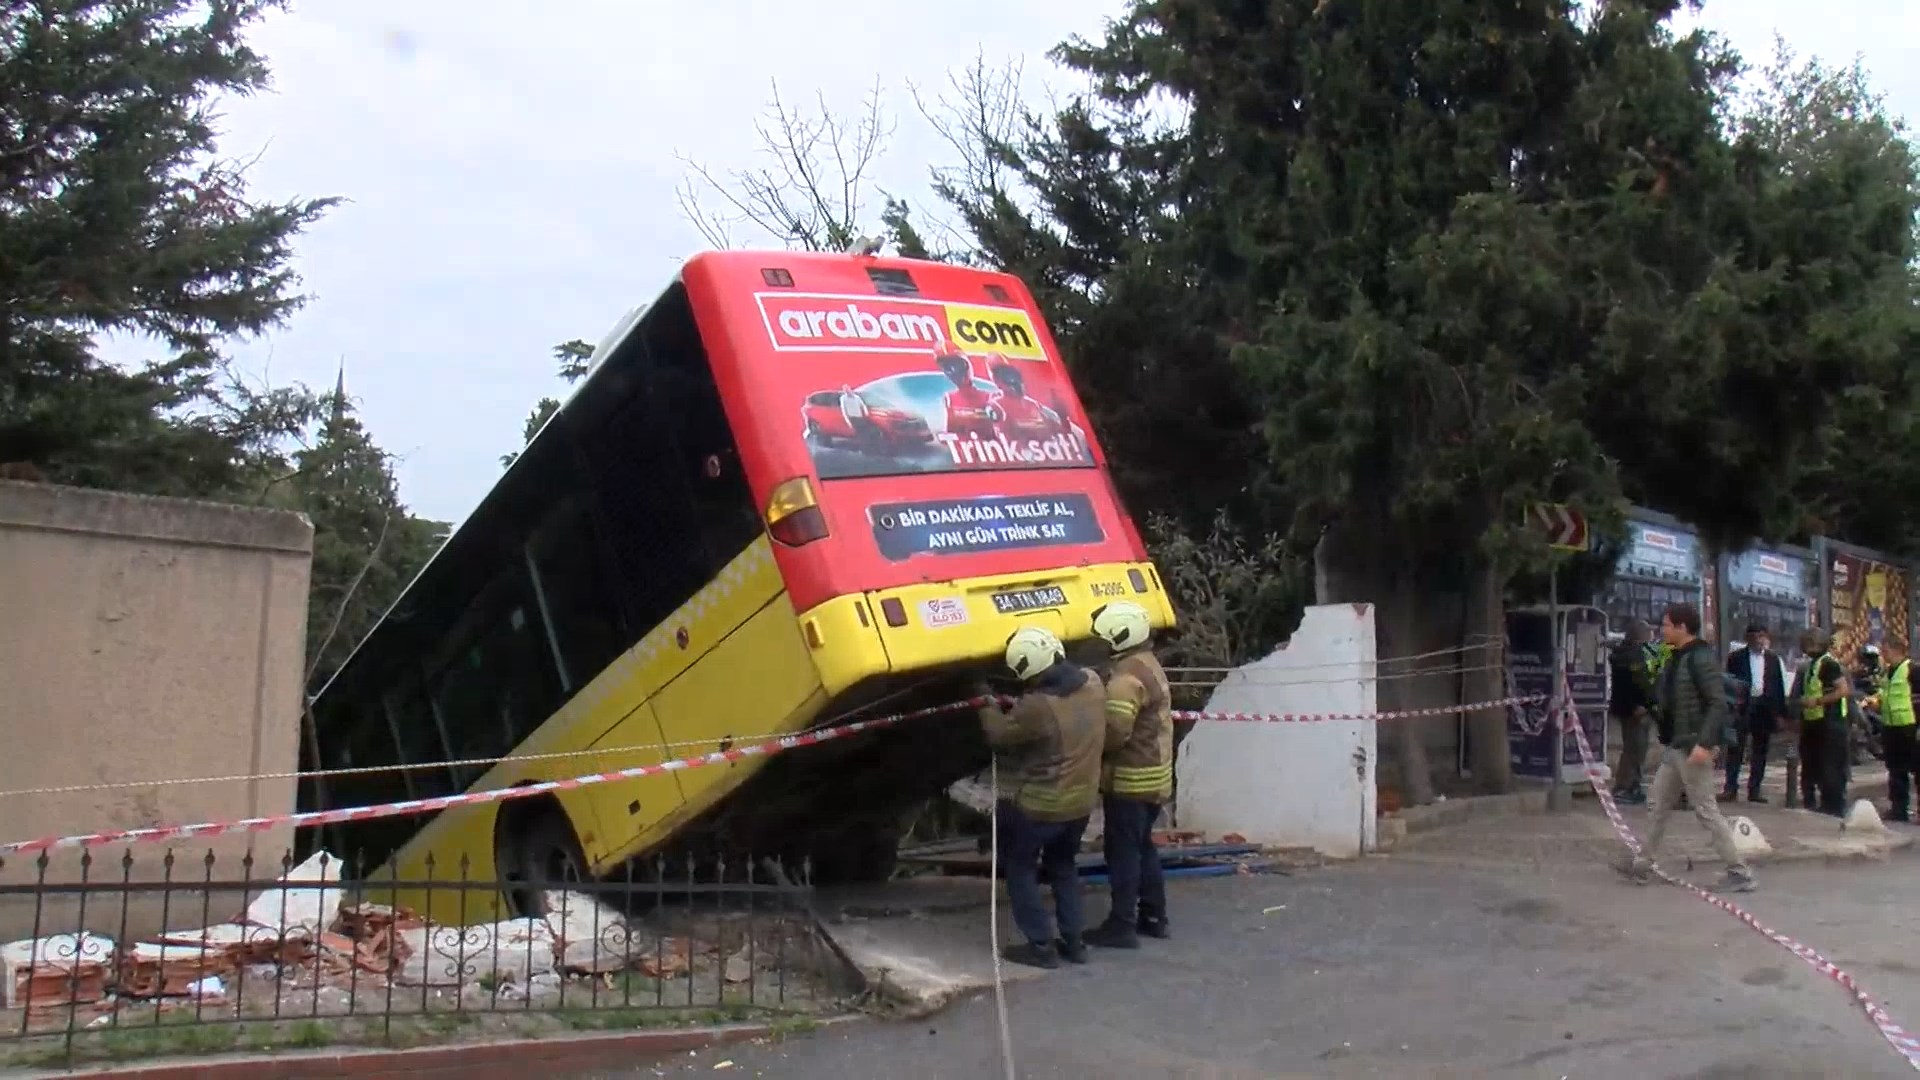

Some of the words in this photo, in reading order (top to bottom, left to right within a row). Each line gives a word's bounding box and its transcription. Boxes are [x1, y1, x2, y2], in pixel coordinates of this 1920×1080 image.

[779, 304, 945, 347] arabam
[955, 319, 1032, 348] com
[938, 431, 1024, 464] Trink
[1028, 433, 1083, 461] sat!
[899, 508, 927, 527] BİR
[928, 504, 1004, 525] DAKİKADA
[1005, 500, 1050, 519] TEKLİF
[1053, 502, 1075, 517] AL,
[929, 530, 963, 548] AYNI
[965, 525, 998, 544] GÜN
[999, 524, 1041, 542] TRİNK
[1042, 524, 1066, 538] SAT
